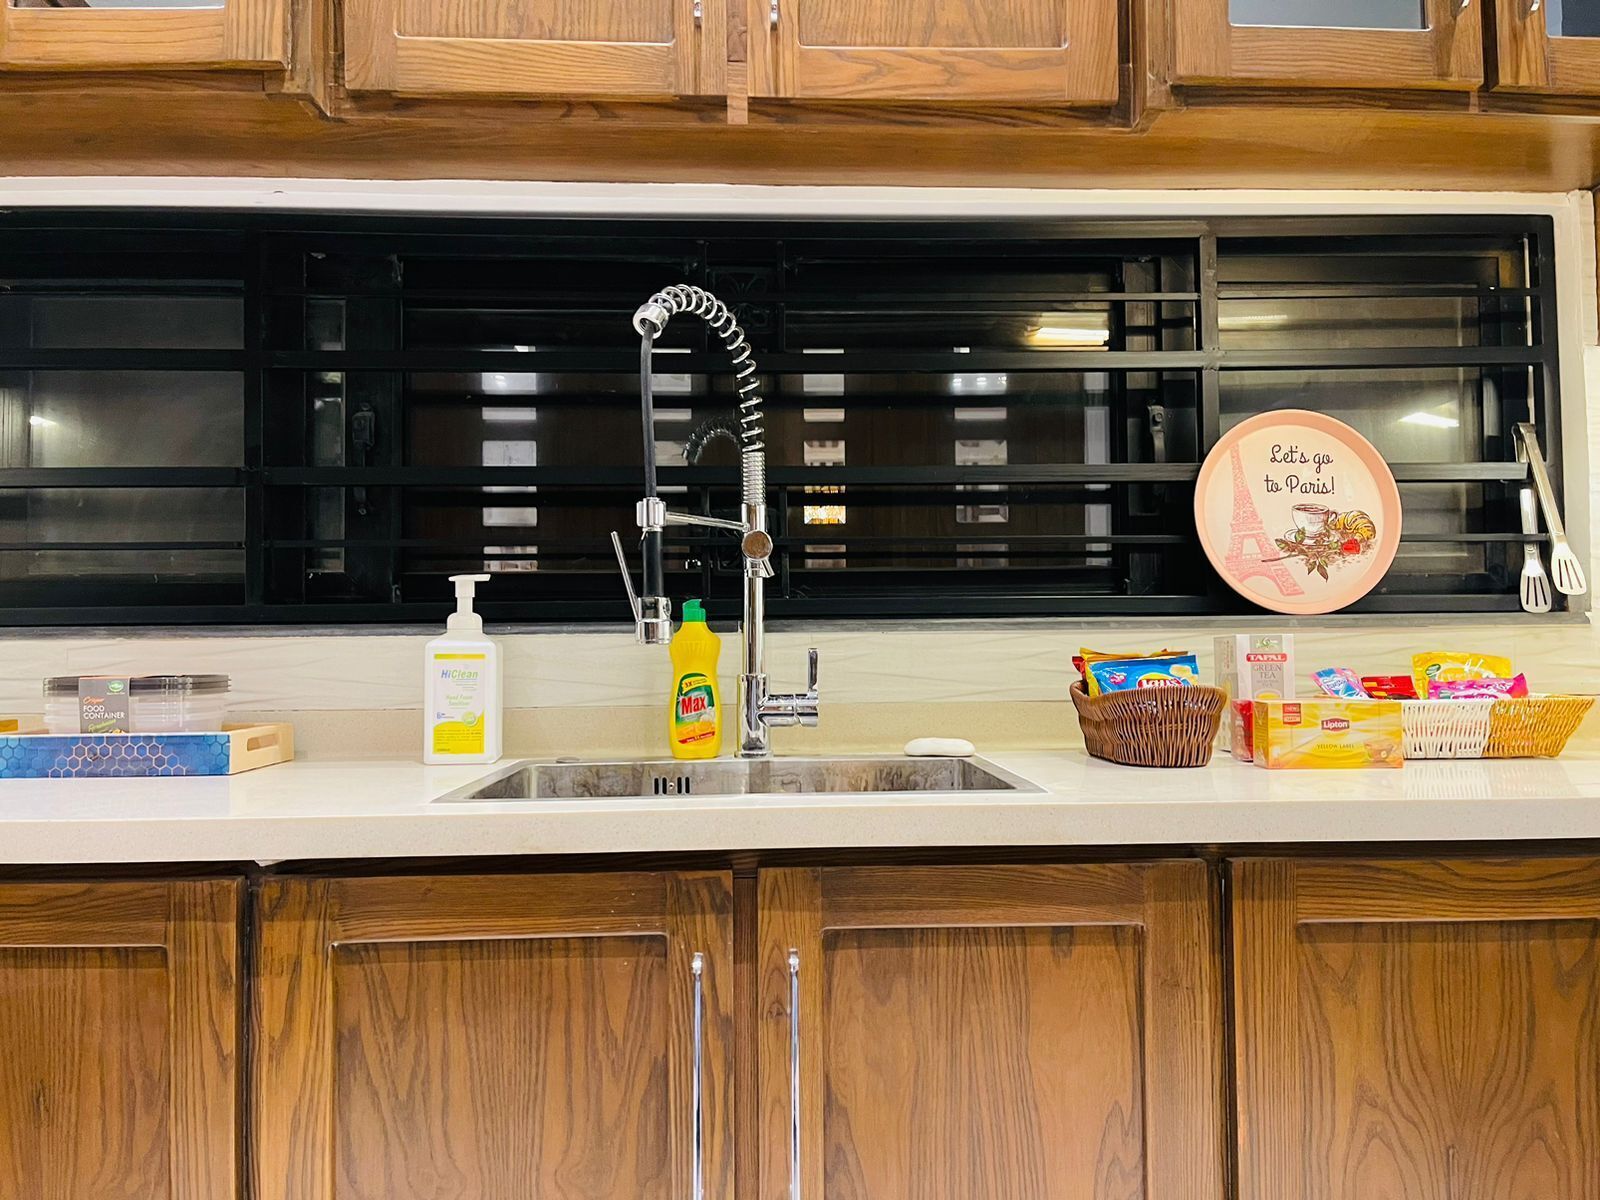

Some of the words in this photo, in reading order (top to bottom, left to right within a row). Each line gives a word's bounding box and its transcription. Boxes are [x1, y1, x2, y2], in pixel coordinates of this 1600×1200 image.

[1269, 444, 1310, 464] Let's
[1313, 452, 1334, 474] go
[1264, 474, 1282, 493] to
[1285, 474, 1335, 495] Paris!
[1254, 663, 1282, 672] GREEN
[441, 669, 479, 679] HiClean
[1260, 671, 1276, 680] TEA
[681, 696, 706, 715] Max
[83, 712, 125, 720] CONTAINER
[1323, 720, 1348, 730] Lipton
